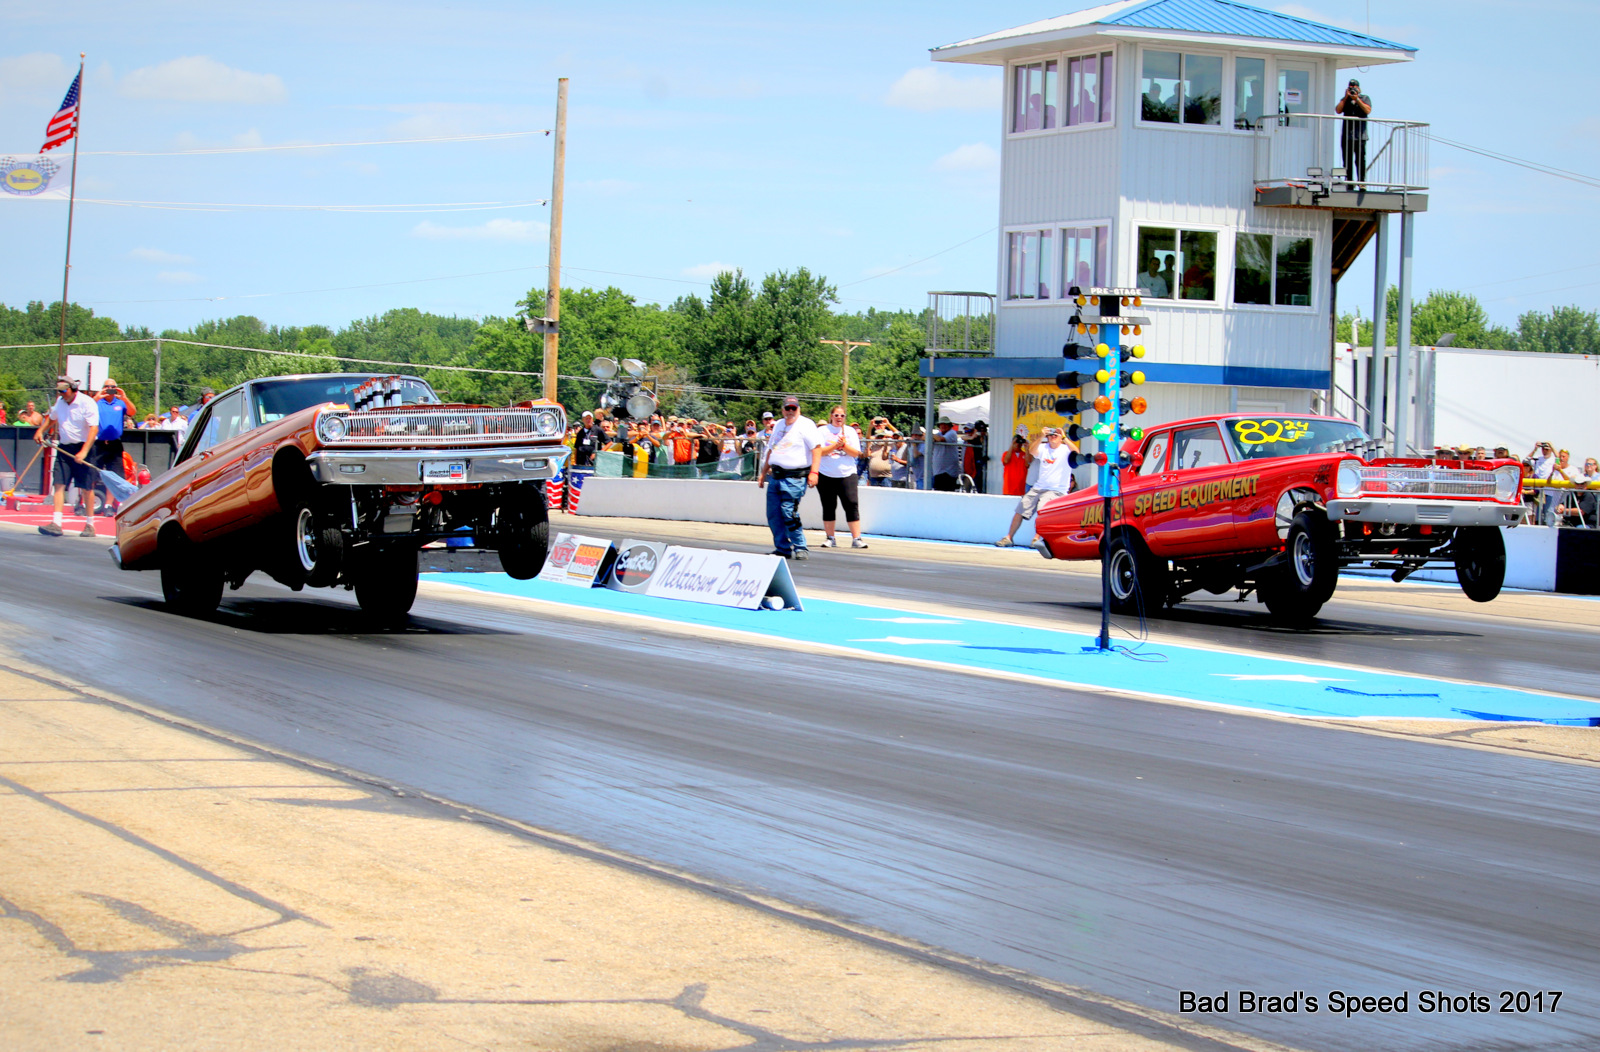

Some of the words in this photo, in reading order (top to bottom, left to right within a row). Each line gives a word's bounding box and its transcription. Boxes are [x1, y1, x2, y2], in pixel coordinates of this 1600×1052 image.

[1090, 287, 1142, 296] PRE-STAGE
[1101, 316, 1130, 324] STAGE
[1017, 393, 1077, 419] WELCO
[1108, 347, 1117, 442] COMPULINK
[1234, 419, 1296, 444] 82
[1283, 420, 1309, 431] 24
[1080, 499, 1124, 527] JAK'S
[1134, 489, 1177, 516] SPEED
[1181, 475, 1260, 511] EQUIPMENT
[656, 552, 718, 593] Meltdown
[716, 561, 762, 606] Drags
